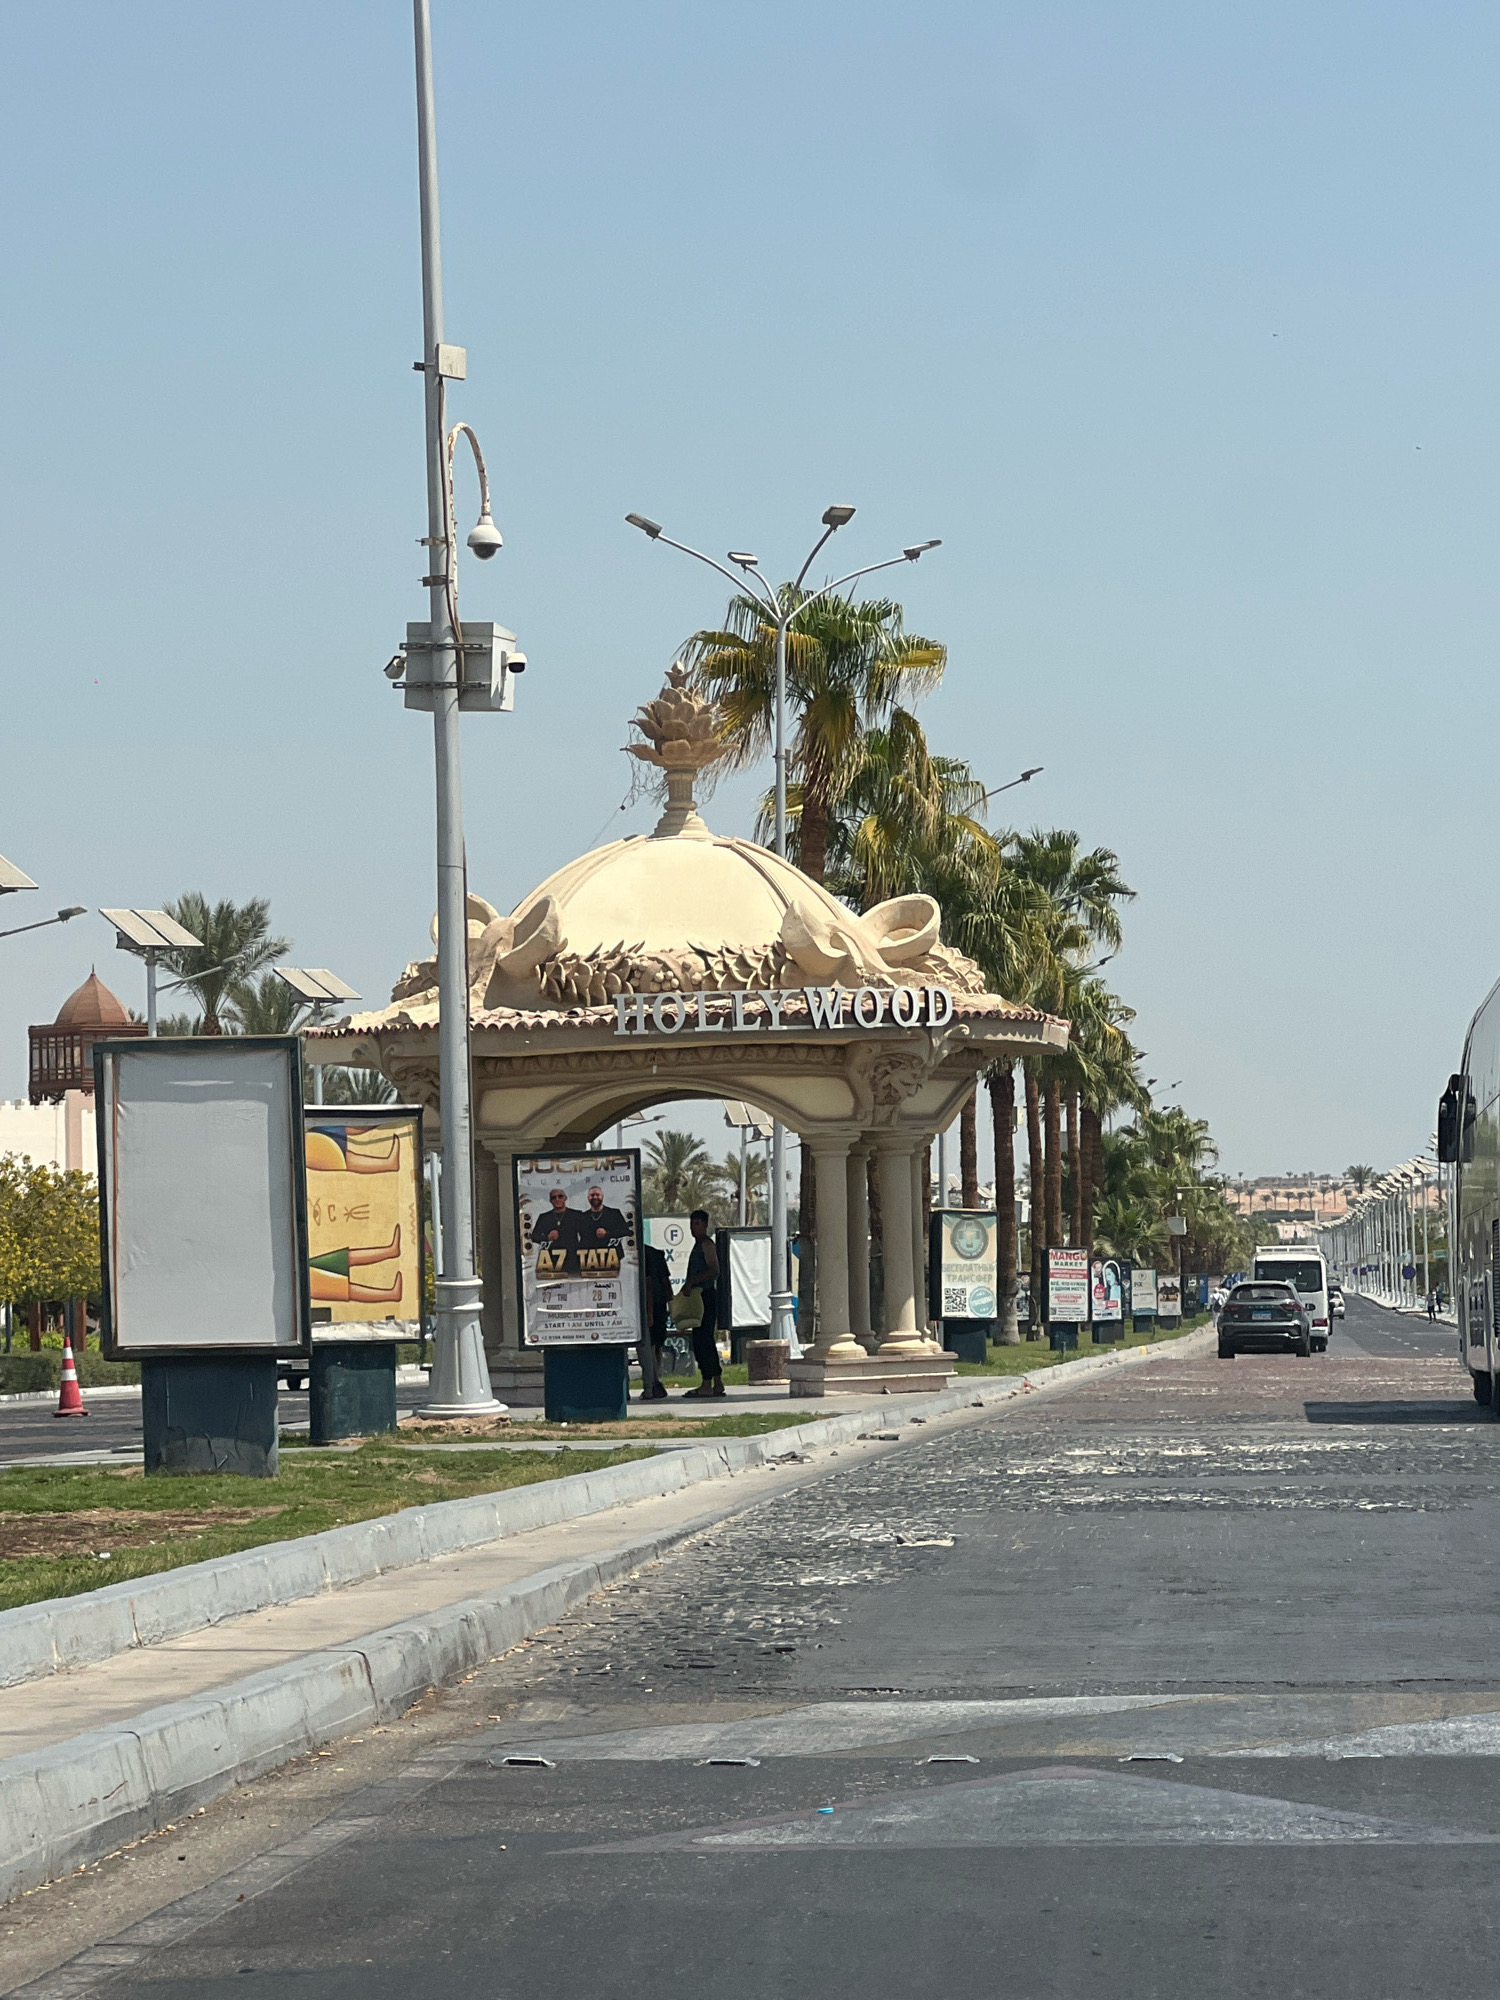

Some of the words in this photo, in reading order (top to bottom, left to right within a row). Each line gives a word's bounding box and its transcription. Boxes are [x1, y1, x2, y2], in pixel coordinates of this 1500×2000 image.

[612, 985, 953, 1035] HOLLYWOOD
[610, 1175, 631, 1183] CLUB
[670, 1229, 678, 1241] F
[540, 1241, 553, 1250] DJ
[607, 1238, 621, 1247] DJ
[537, 1249, 567, 1272] A7
[577, 1248, 619, 1270] TATA
[1050, 1251, 1087, 1261] MANGO
[548, 1311, 572, 1319] MUSIC
[573, 1311, 583, 1319] BY
[596, 1309, 618, 1318] LUCA
[611, 1318, 623, 1326] AM
